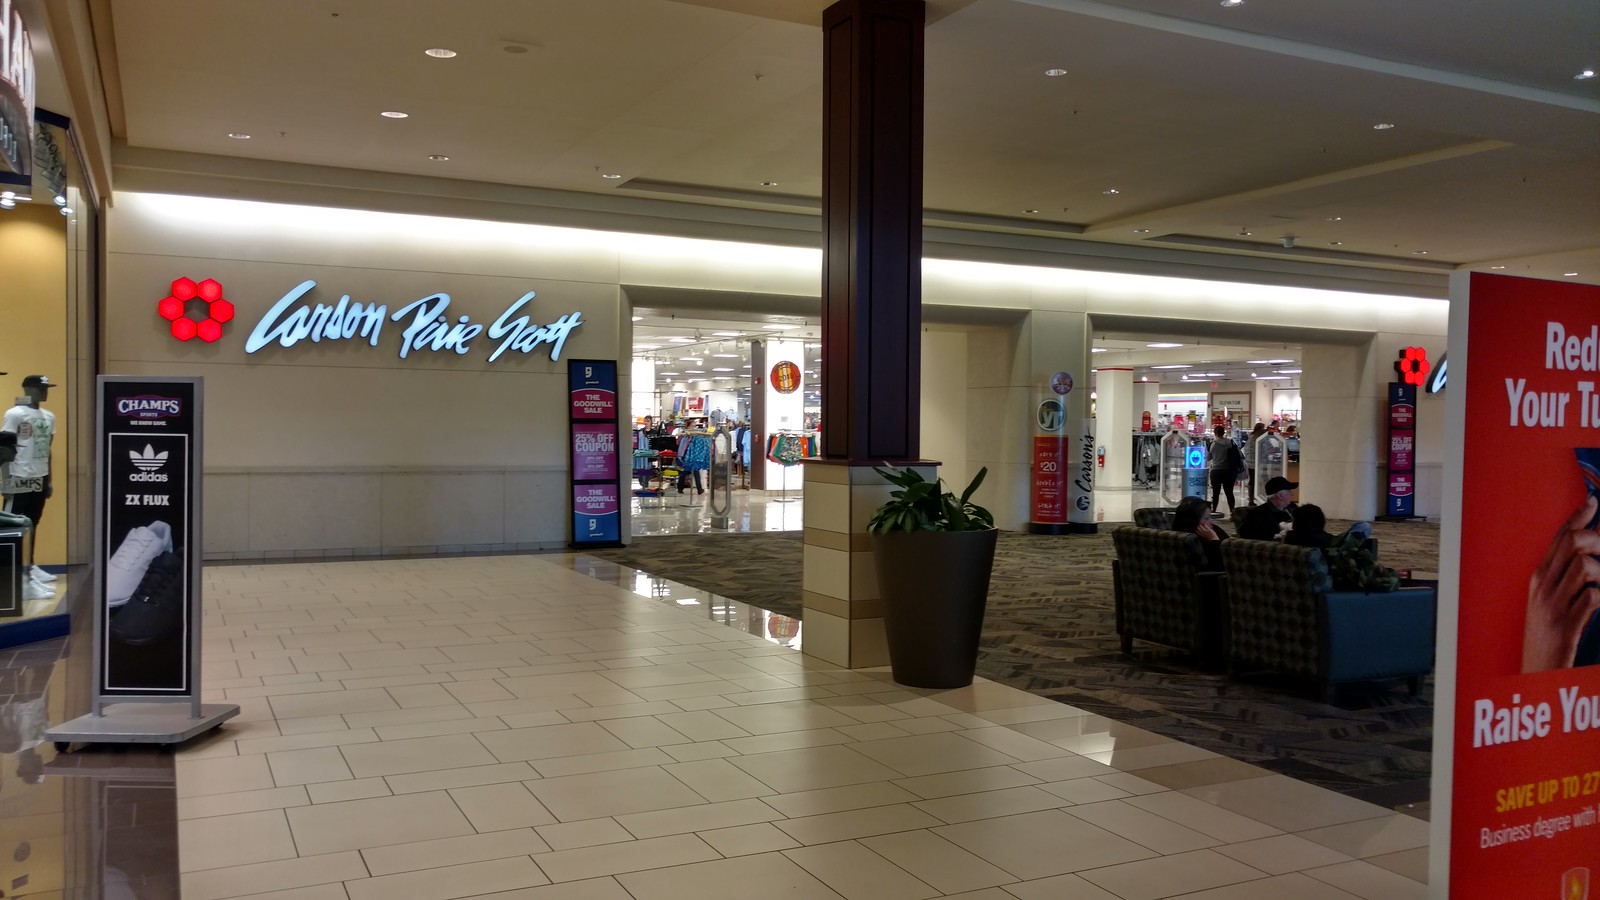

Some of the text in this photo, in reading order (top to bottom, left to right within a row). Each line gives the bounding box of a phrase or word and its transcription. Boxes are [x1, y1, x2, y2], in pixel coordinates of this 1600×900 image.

[245, 279, 586, 363] Carson Pirie Scott
[118, 399, 180, 414] CHAMPS
[1505, 378, 1570, 428] Your
[575, 433, 614, 443] 25% OFF
[575, 442, 614, 452] COUPON
[1039, 461, 1057, 472] $20
[1074, 427, 1095, 493] Carson's
[129, 472, 169, 482] adidas
[125, 494, 170, 506] ZX FLUX
[1473, 693, 1551, 748] Raise
[1495, 783, 1535, 813] SAVE
[1537, 778, 1559, 804] UP
[1562, 775, 1580, 799] TO
[1480, 823, 1532, 849] Business
[1532, 815, 1572, 839] degree
[1572, 805, 1596, 828] with
